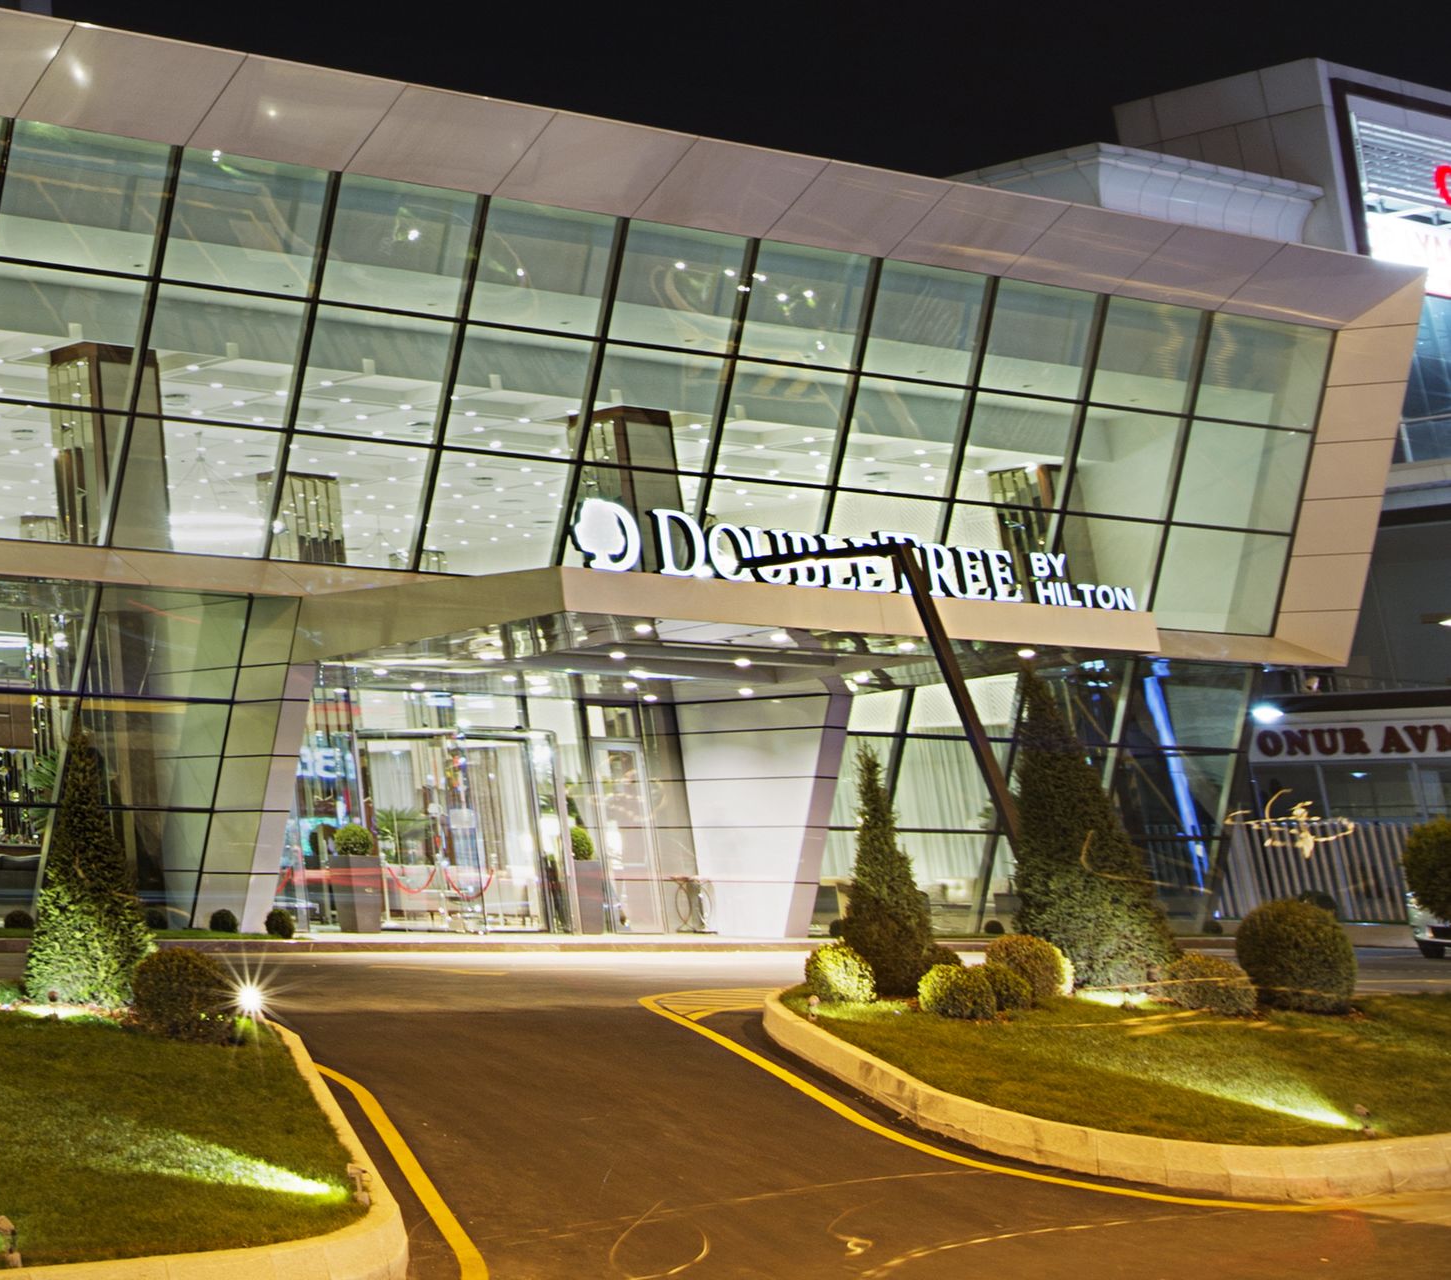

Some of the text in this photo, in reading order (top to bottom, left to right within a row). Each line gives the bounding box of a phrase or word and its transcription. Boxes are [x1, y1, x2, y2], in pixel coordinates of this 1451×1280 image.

[1029, 552, 1067, 578] BY
[1035, 581, 1137, 611] HILTON
[1256, 727, 1372, 757] ONUR
